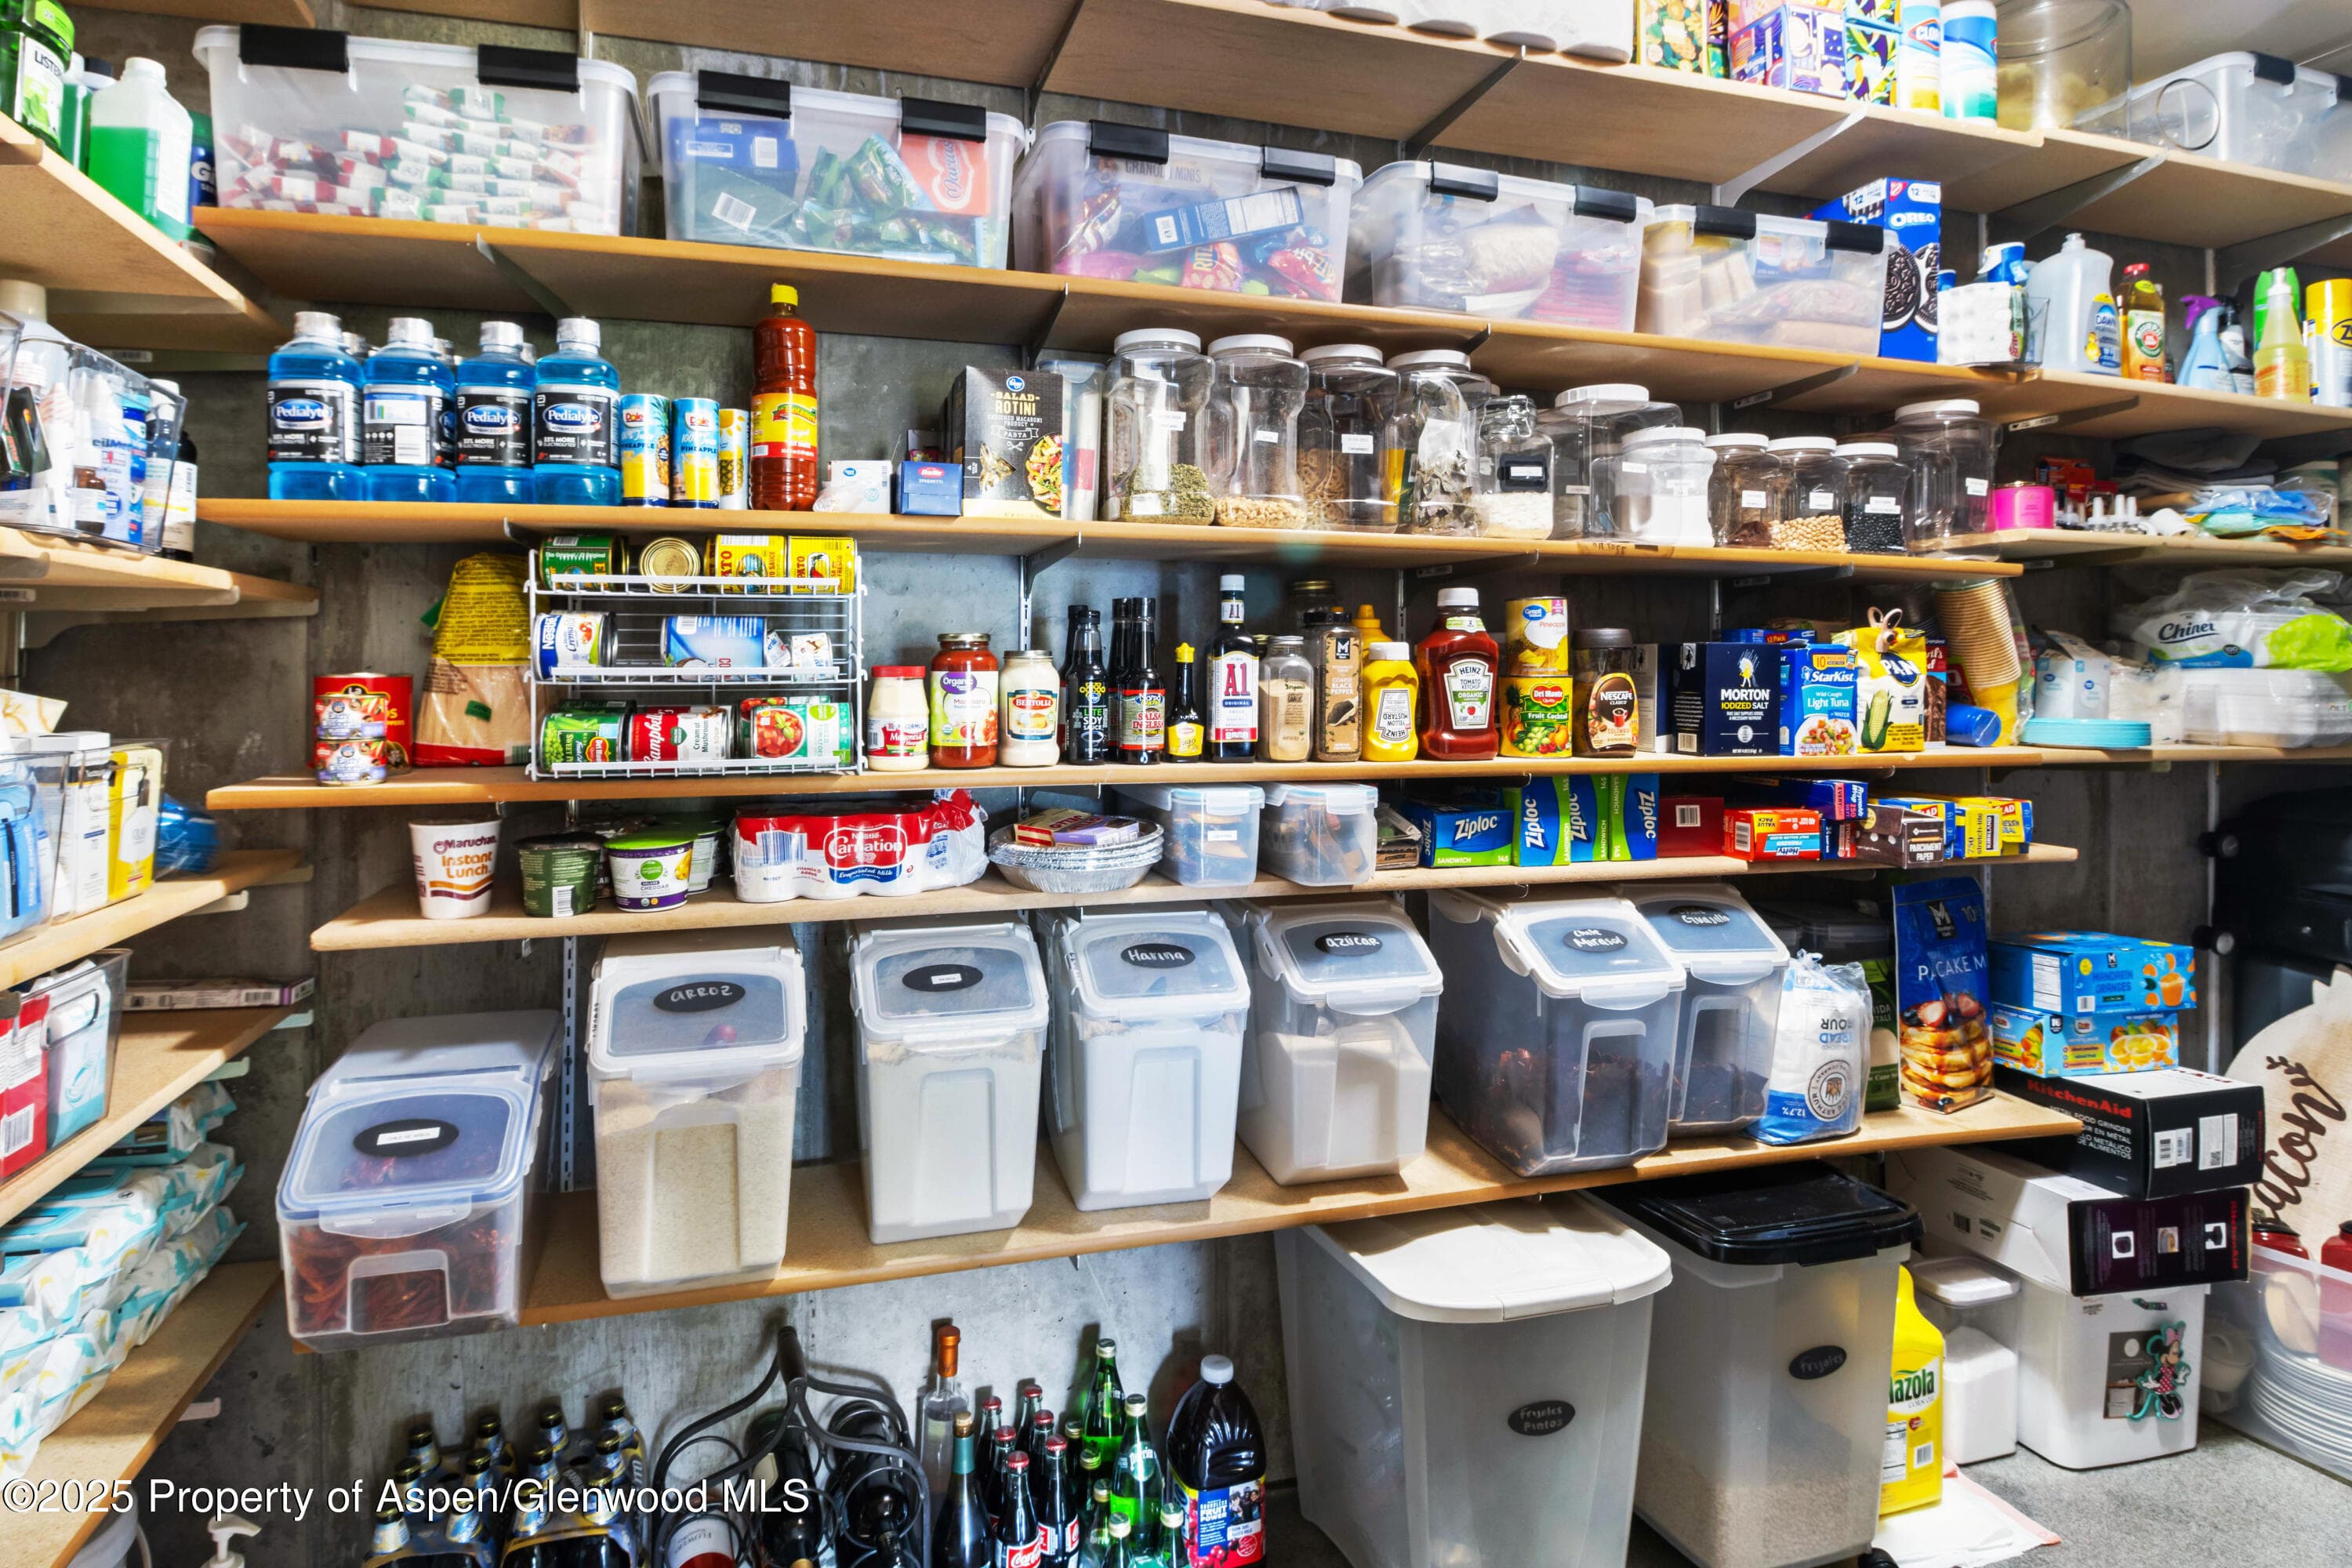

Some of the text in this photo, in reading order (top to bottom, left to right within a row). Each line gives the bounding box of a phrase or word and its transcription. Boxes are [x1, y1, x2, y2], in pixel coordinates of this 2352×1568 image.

[1174, 166, 1202, 183] MINIS
[1911, 186, 1920, 196] 12
[1853, 194, 1864, 205] 12
[1889, 212, 1936, 228] OREO
[1192, 245, 1214, 272] RITZ
[995, 401, 1036, 416] ROTINI
[467, 410, 518, 424] Pedialyte
[548, 409, 598, 424] Pedialyte
[626, 412, 644, 422] Dole
[1816, 656, 1826, 668] 10
[1459, 666, 1481, 675] HEINZ
[1811, 670, 1854, 682] StarKist
[1223, 662, 1250, 696] A1
[1720, 688, 1770, 701] MORTON
[1807, 698, 1849, 710] Light Tuna
[1083, 716, 1102, 725] SOY
[1385, 729, 1406, 738] HEINZ
[1856, 785, 1864, 817] Reynolds
[1570, 793, 1587, 841] Ziploc
[1637, 790, 1657, 840] Ziploc
[1454, 815, 1498, 840] Ziploc
[1525, 798, 1544, 848] Ziploc
[1777, 847, 1799, 856] Hefty
[1909, 842, 1944, 852] PARCHMENT
[441, 851, 493, 867] Instant
[1915, 852, 1934, 862] PAPER
[446, 864, 488, 879] Lunch
[839, 869, 876, 879] Evaporated
[1127, 949, 1185, 963] Harina
[2094, 982, 2132, 993] ORANGES
[1819, 1033, 1852, 1044] READ
[2027, 1079, 2132, 1119] KitchenAid
[2074, 1112, 2132, 1134] FOOD GRINDER
[2089, 1142, 2132, 1160] ALIMENTOS
[1200, 1505, 1228, 1516] FRUIT
[1200, 1512, 1228, 1523] POWER
